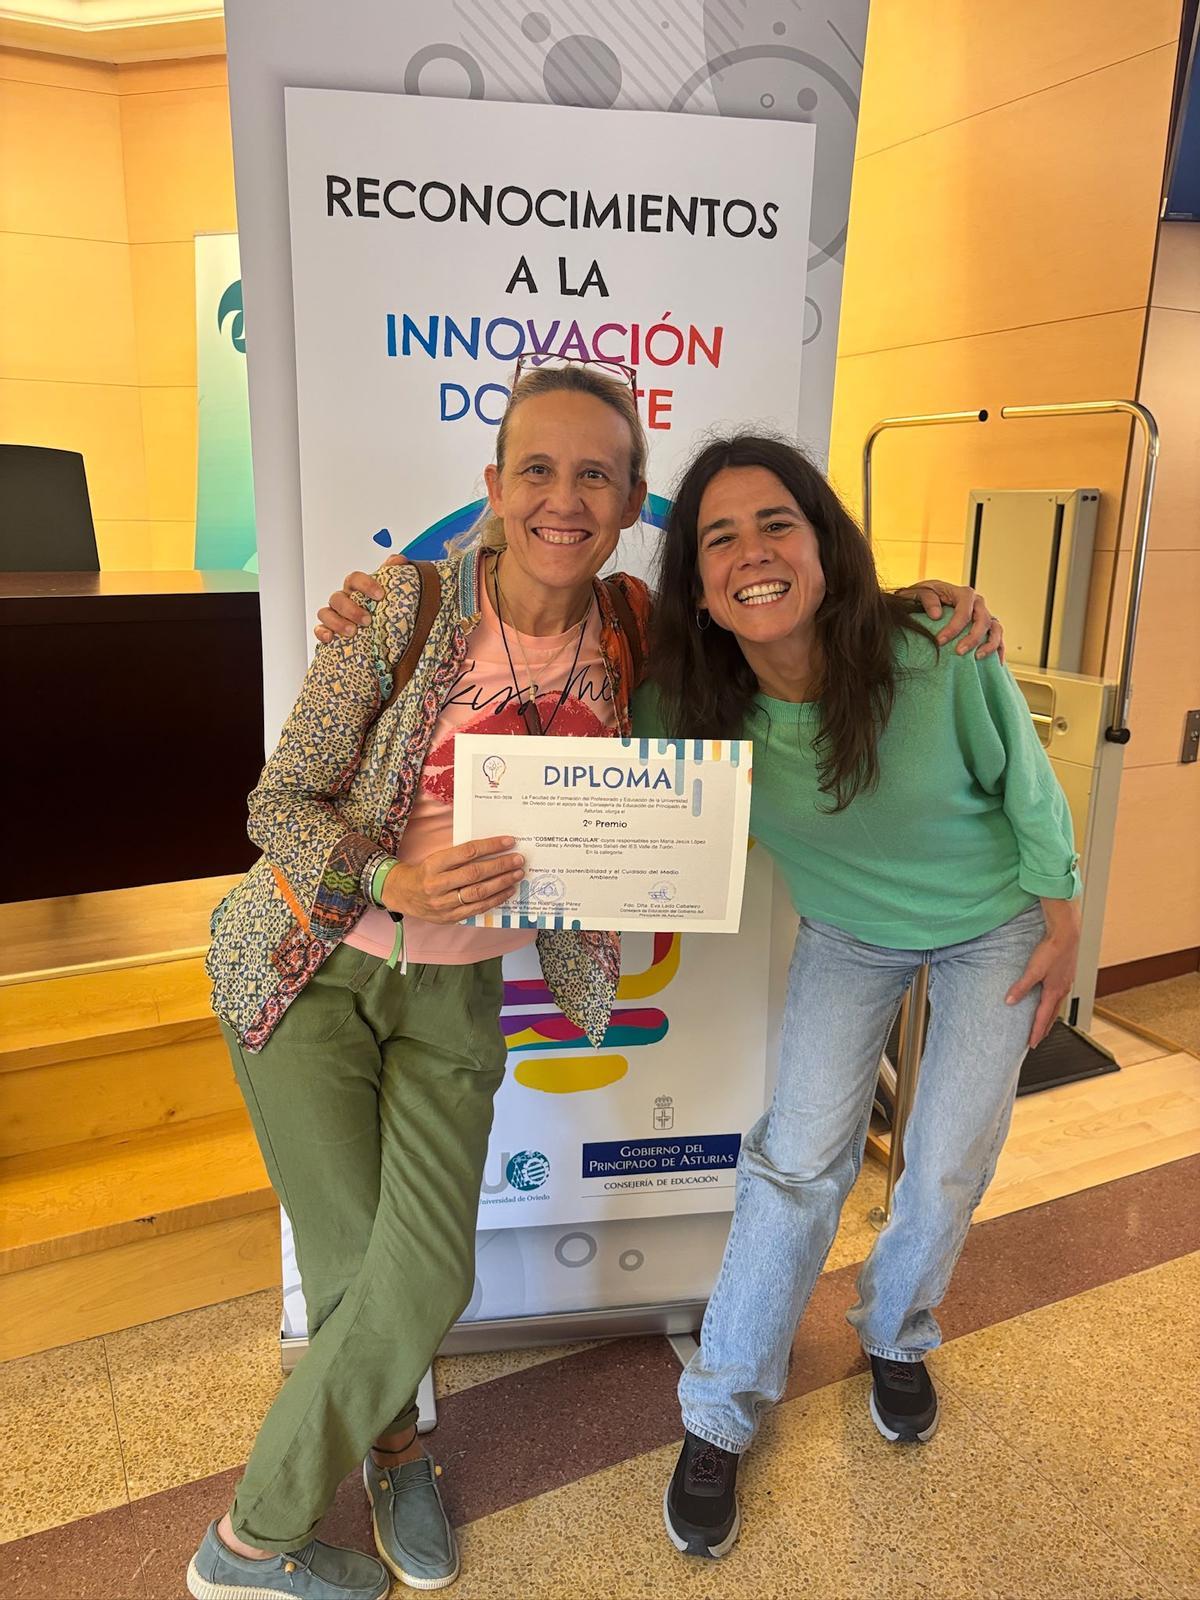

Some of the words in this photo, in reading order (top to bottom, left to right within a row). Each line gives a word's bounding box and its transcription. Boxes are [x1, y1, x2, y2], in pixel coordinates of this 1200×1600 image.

[326, 175, 779, 239] RECONOCIMIENTOS
[505, 255, 538, 294] A
[558, 256, 609, 297] LA
[386, 311, 724, 368] INNOVACIÓN
[544, 765, 672, 789] DIPLOMA
[596, 820, 628, 828] Premio
[620, 1145, 681, 1158] GOBIERNO
[685, 1144, 704, 1153] DEL
[589, 1158, 657, 1172] PRINCIPADO
[661, 1157, 676, 1167] DE
[680, 1153, 735, 1166] ASTURIAS
[603, 1176, 653, 1190] CONSEJERÍA
[656, 1178, 668, 1186] DE
[670, 1175, 719, 1186] EDUCACIÓN
[526, 1194, 551, 1202] Oviedo
